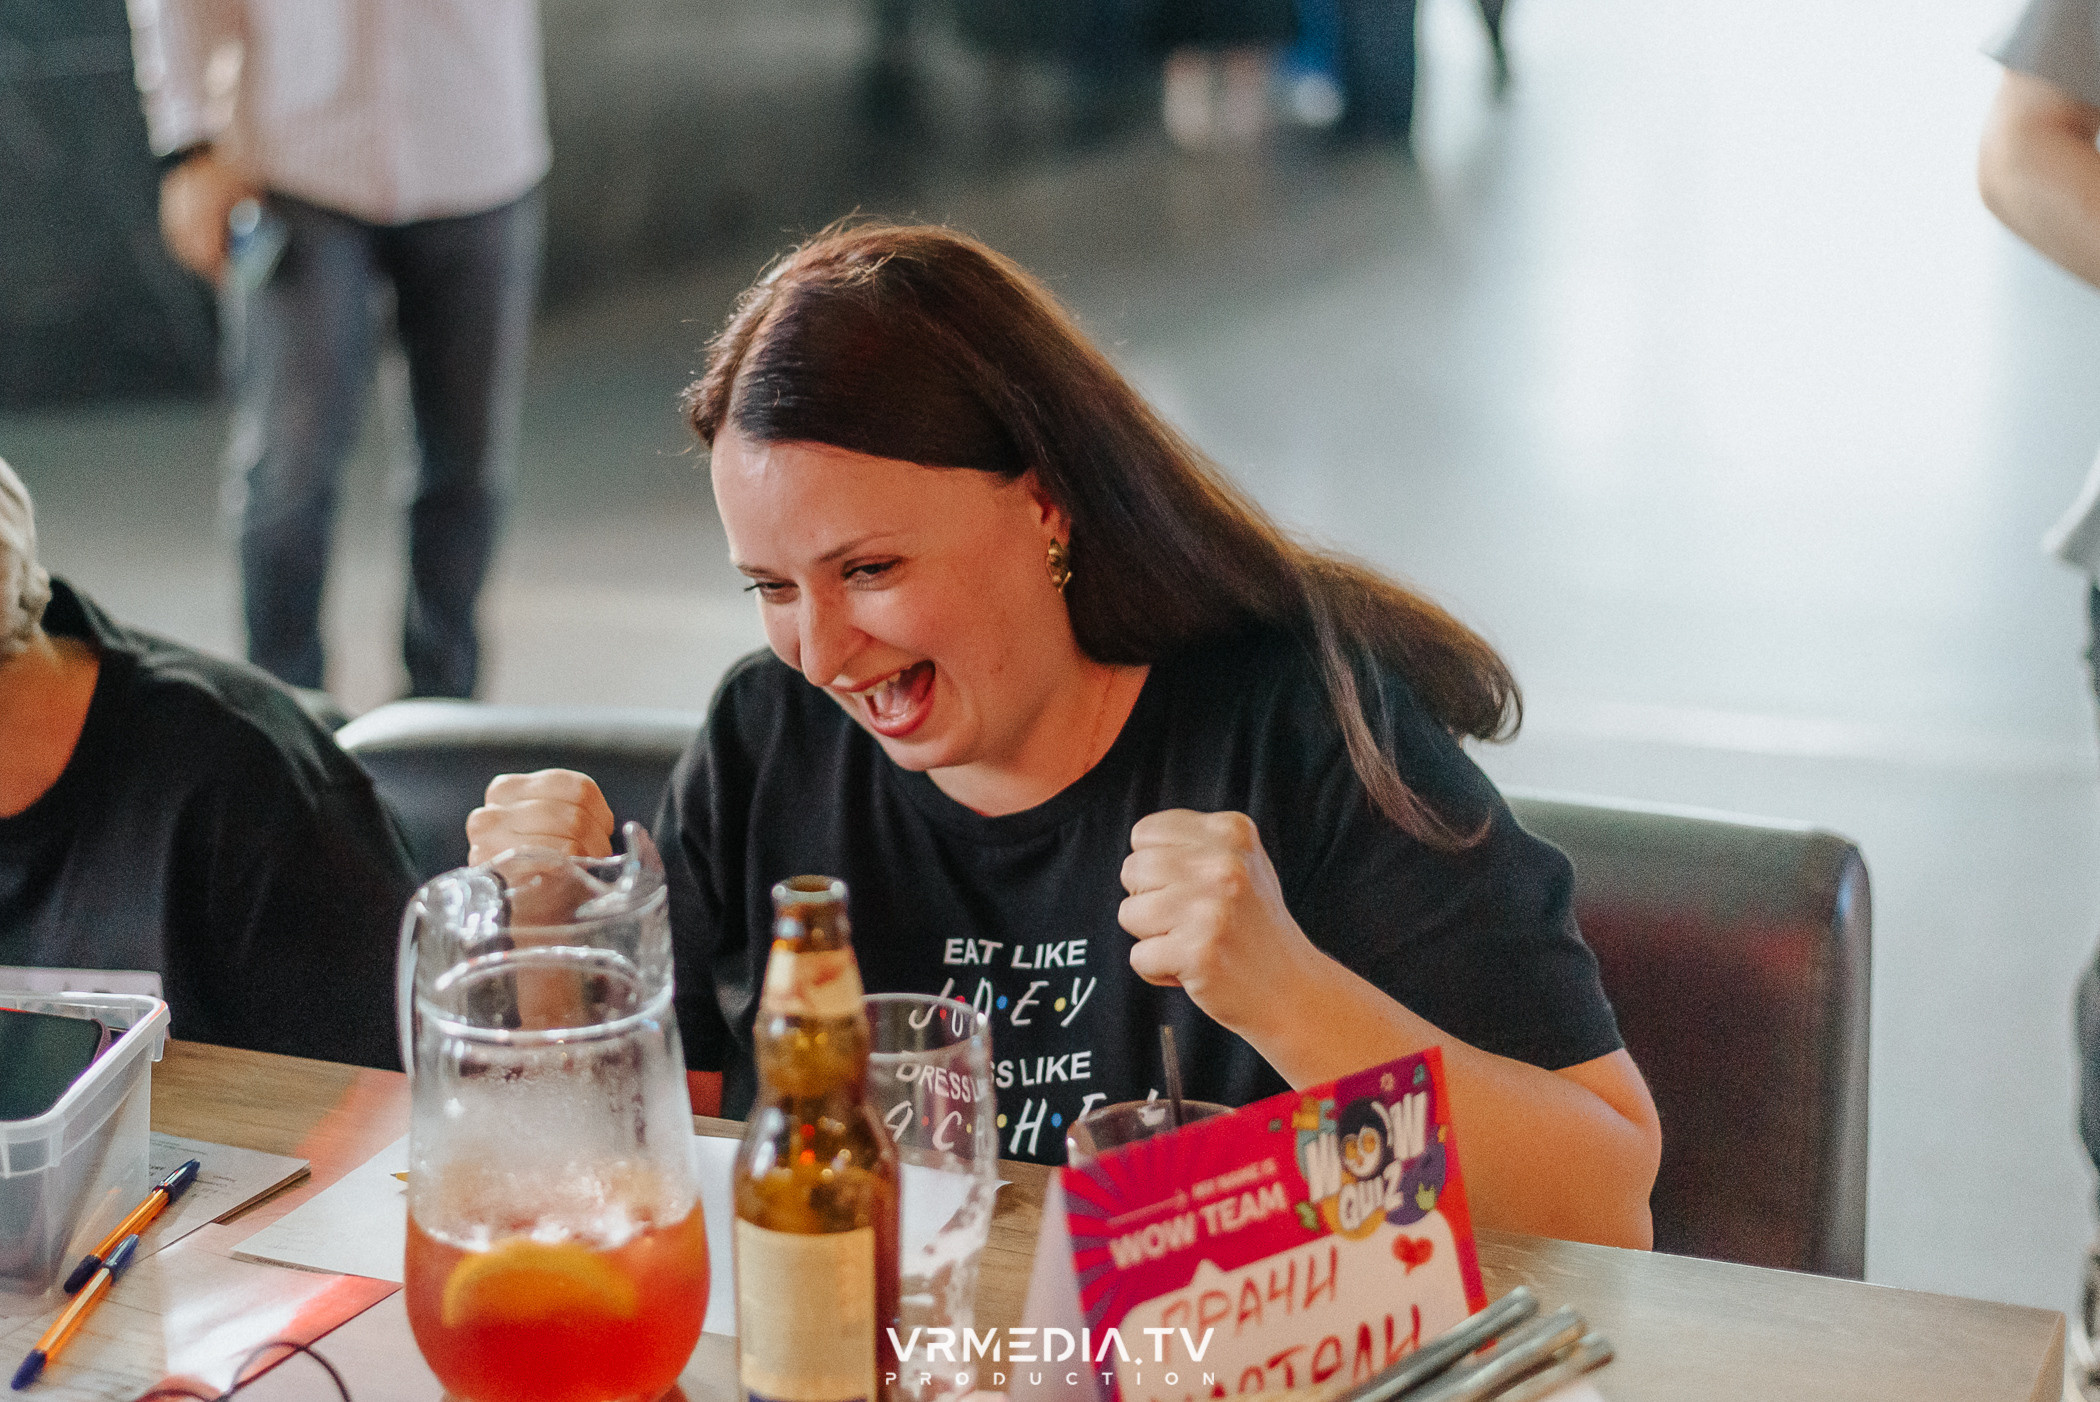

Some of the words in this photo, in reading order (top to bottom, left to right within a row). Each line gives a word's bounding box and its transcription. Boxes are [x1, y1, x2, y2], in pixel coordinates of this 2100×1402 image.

[943, 938, 1004, 966] EAT
[1010, 938, 1088, 969] LIKE
[1019, 1050, 1093, 1087] LIKE
[1304, 1090, 1428, 1203] WOW
[1109, 1211, 1197, 1270] WOW
[1201, 1181, 1288, 1237] TEAM
[1338, 1159, 1405, 1231] QUIZ
